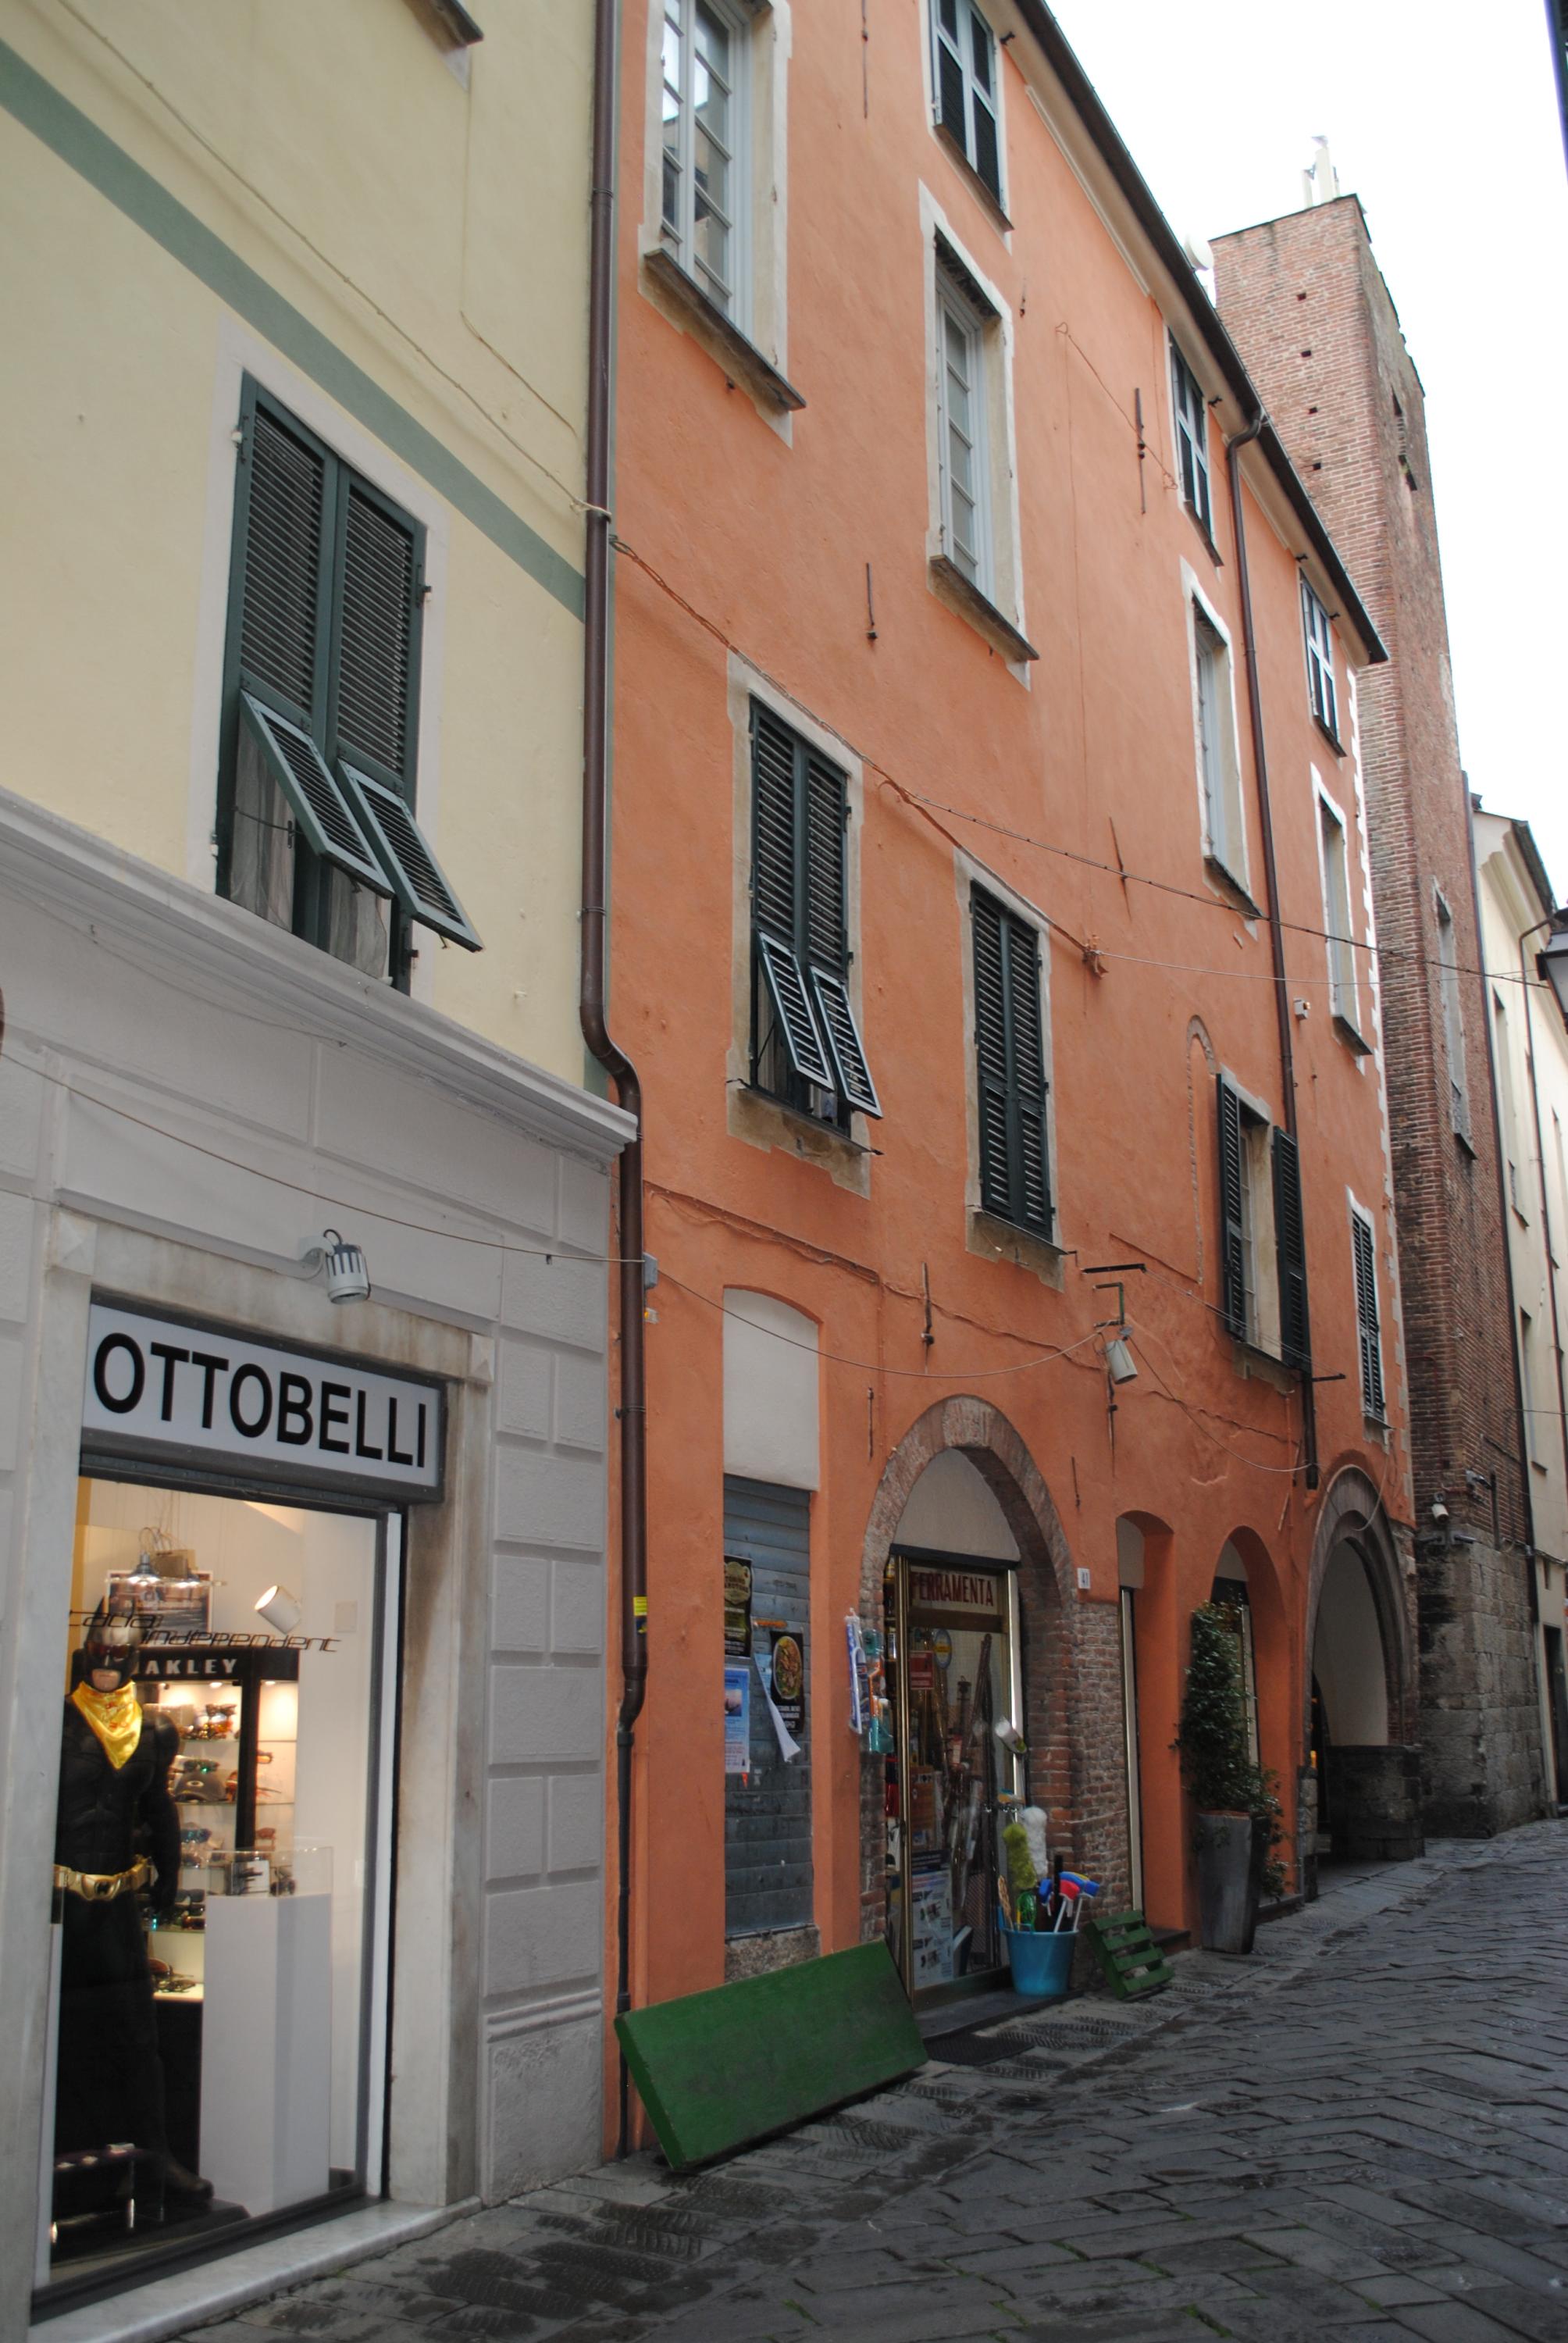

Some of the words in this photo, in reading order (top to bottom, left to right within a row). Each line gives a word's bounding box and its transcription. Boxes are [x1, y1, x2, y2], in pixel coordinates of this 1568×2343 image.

[94, 1332, 426, 1467] OTTOBELLI
[910, 1571, 994, 1607] FERRAMENTA
[141, 1628, 342, 1653] independent
